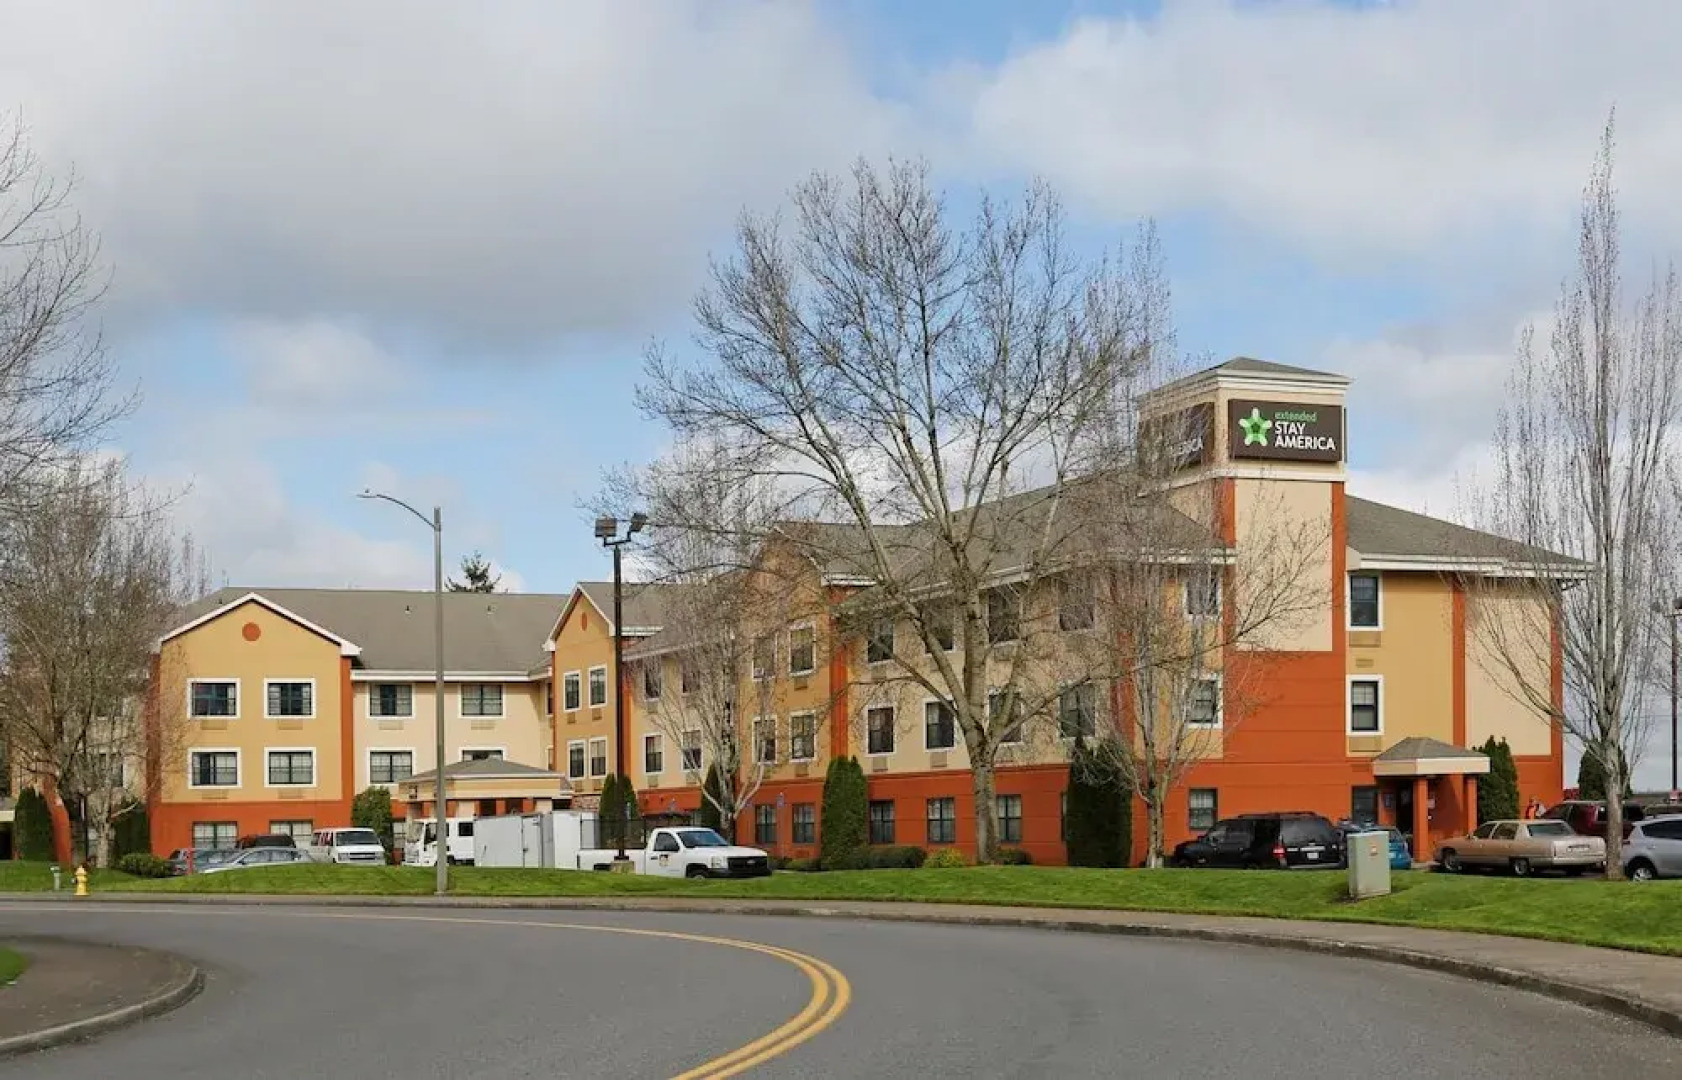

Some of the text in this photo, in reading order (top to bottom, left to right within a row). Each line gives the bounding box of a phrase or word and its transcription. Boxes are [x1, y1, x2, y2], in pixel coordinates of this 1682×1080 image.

[1275, 411, 1317, 422] extended
[1275, 421, 1305, 434] STAY
[1275, 435, 1335, 450] AMERICA
